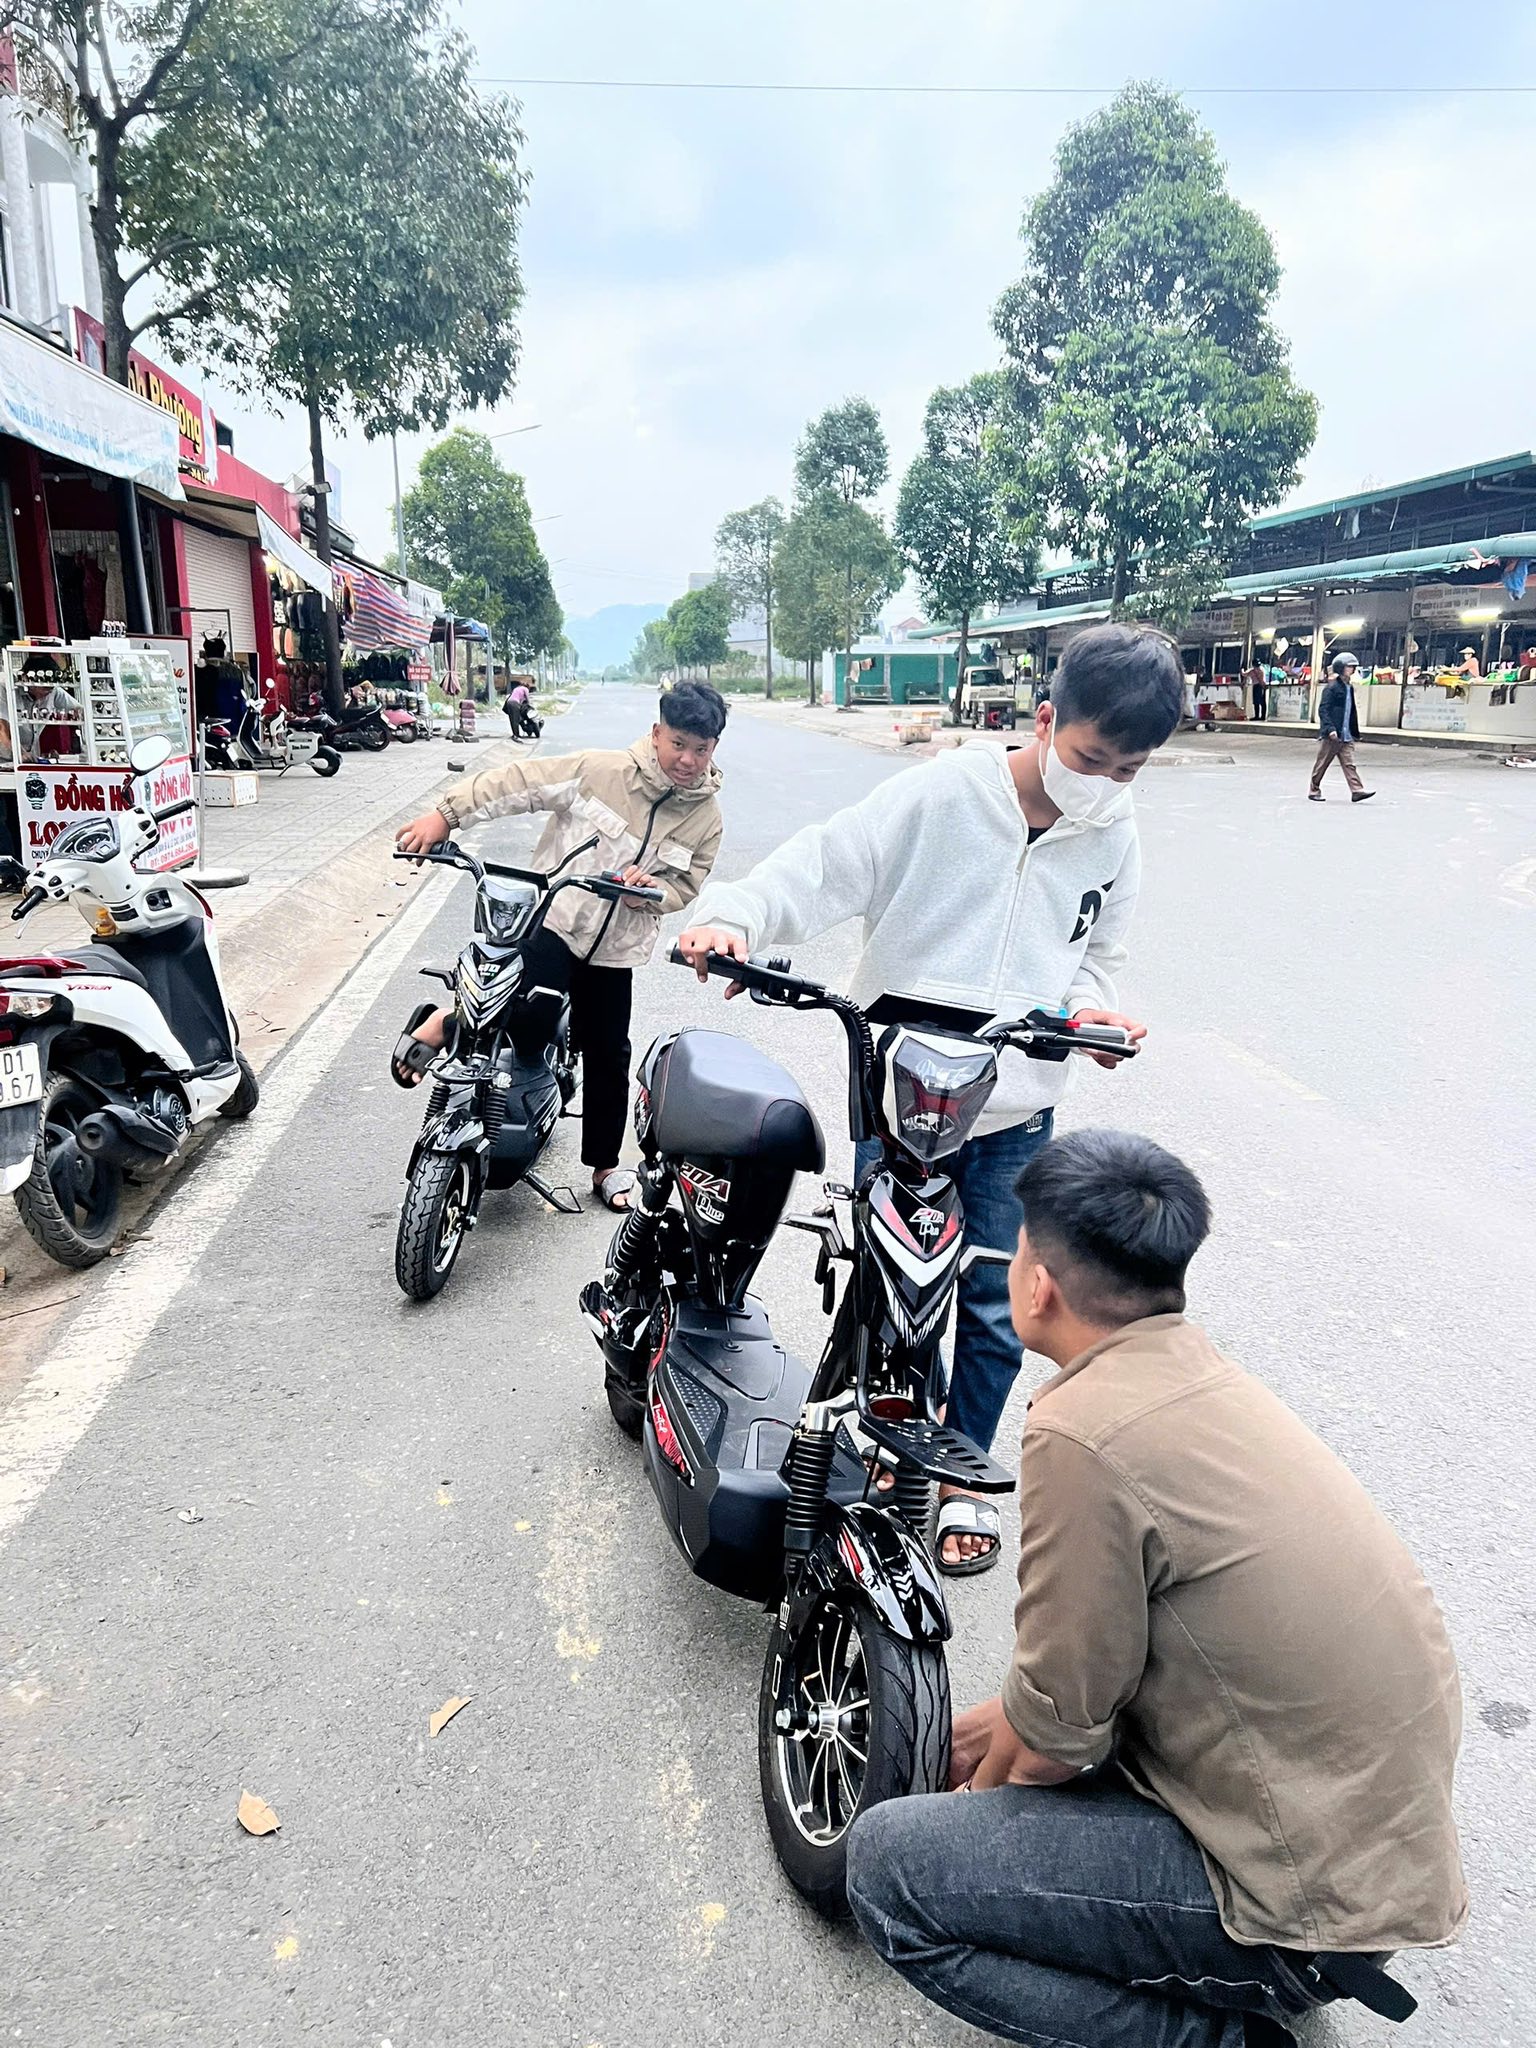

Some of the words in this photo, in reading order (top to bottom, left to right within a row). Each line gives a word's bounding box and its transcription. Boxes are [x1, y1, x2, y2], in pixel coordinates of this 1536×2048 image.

[54, 773, 105, 811] ĐỒNG
[154, 769, 178, 806] ĐỒNG
[179, 762, 191, 799] HỒ
